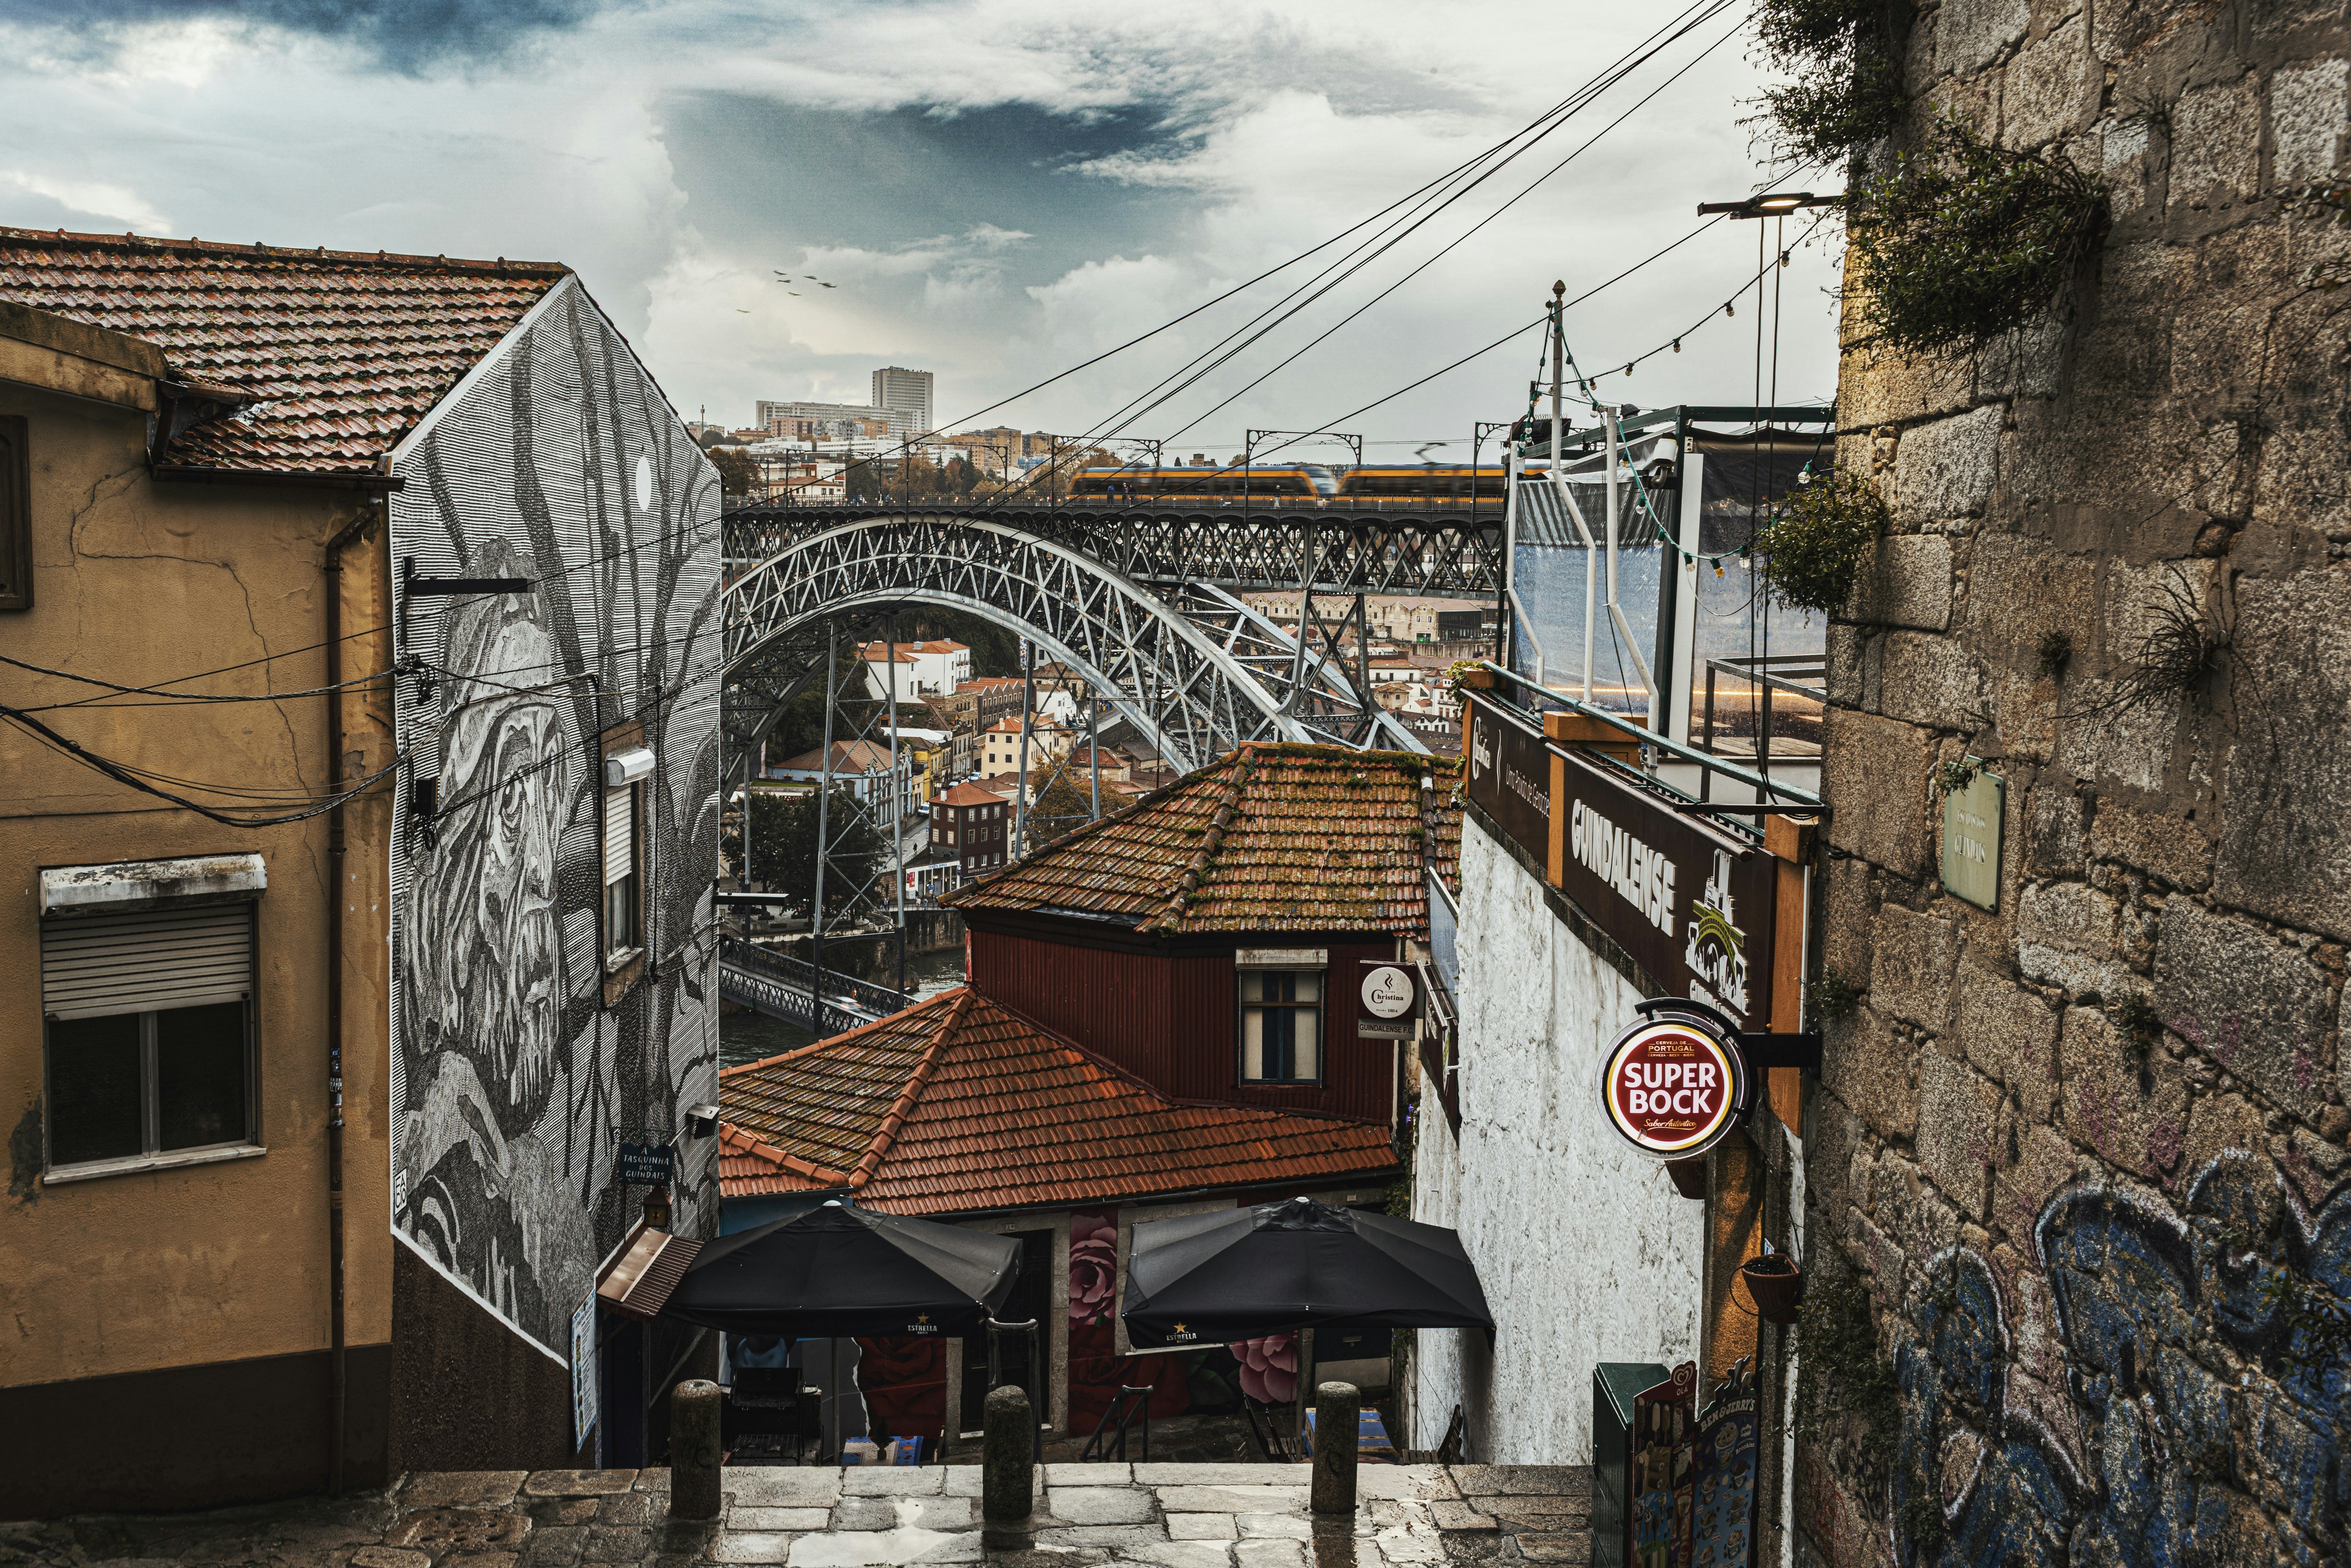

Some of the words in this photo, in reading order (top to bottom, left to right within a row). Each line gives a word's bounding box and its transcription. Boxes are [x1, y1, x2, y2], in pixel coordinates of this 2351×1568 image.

[1506, 763, 1516, 789] Uma
[1515, 770, 1527, 800] Paixão
[1527, 779, 1533, 804] de
[1955, 832, 1986, 864] GUINDAIS
[1572, 799, 1677, 938] GUINDALENSE
[1371, 989, 1404, 1004] Christina
[1359, 1024, 1402, 1033] GUINDALENSE
[1624, 1063, 1716, 1089] SUPER
[1629, 1089, 1712, 1115] BOCK
[1644, 1118, 1665, 1127] Sabor
[641, 1147, 647, 1155] A
[624, 1155, 669, 1166] TASQUINHA
[626, 1170, 665, 1180] GUINDAIS
[1166, 1332, 1197, 1341] ESTRELLA
[1676, 1383, 1688, 1396] OLÁ
[1700, 1409, 1719, 1433] BEN
[1735, 1442, 1755, 1455] Brookies
